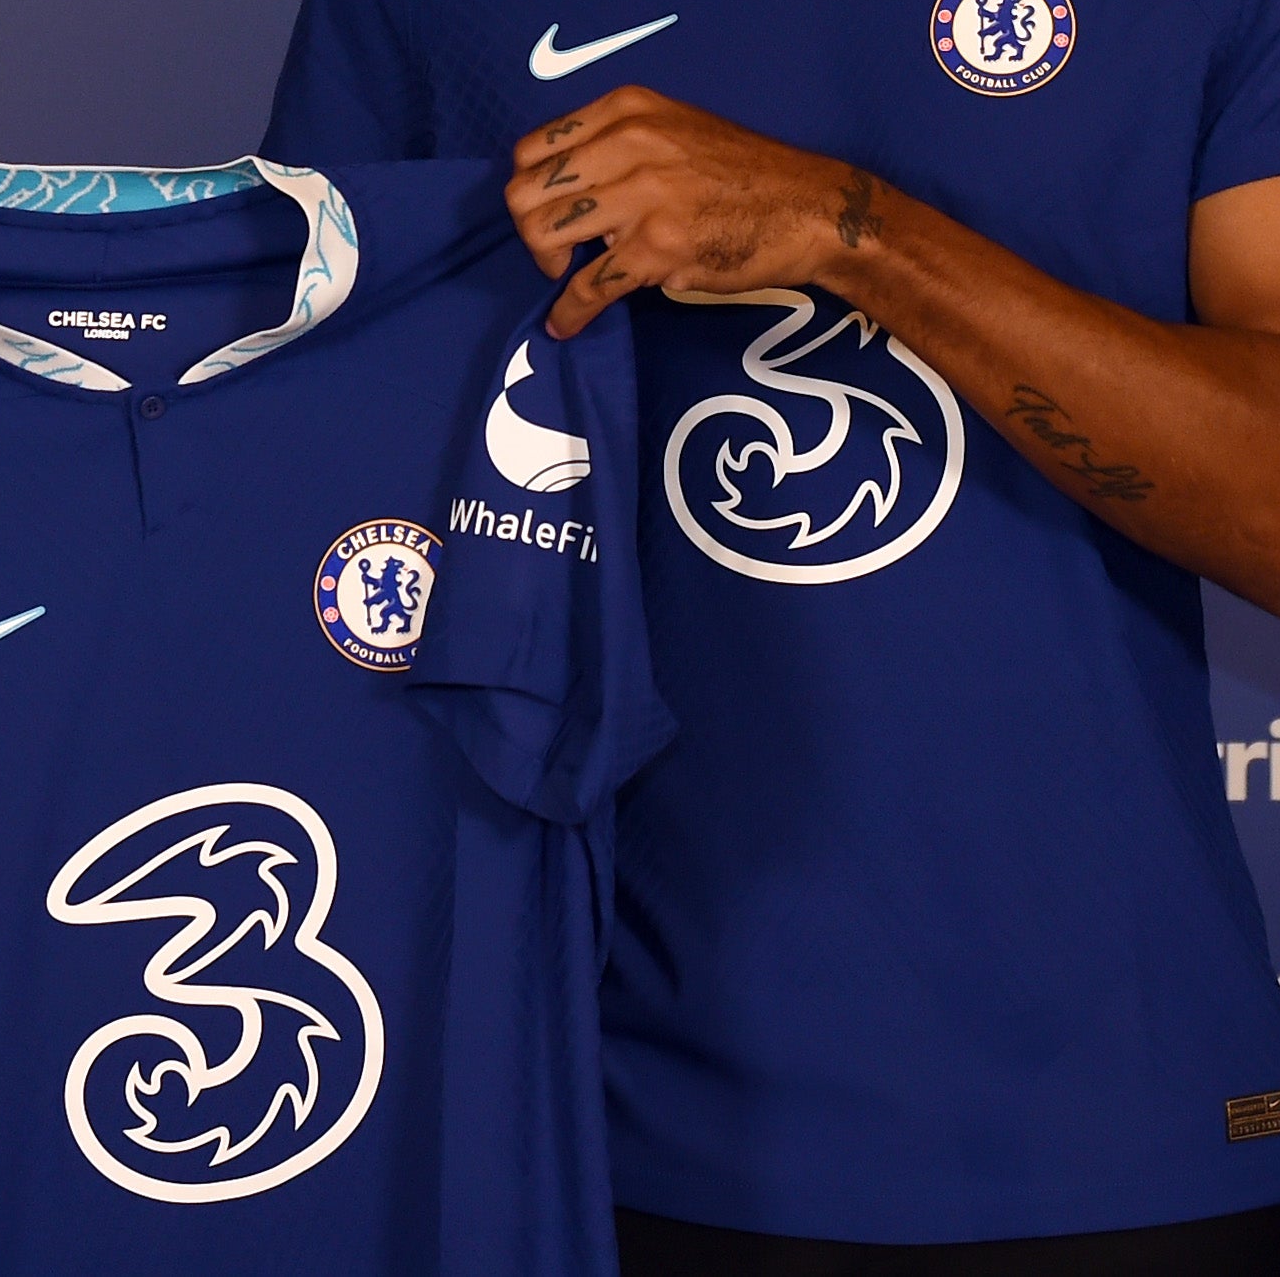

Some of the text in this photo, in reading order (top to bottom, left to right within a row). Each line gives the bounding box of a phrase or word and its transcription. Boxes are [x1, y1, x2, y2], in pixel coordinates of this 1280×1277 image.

[955, 61, 1053, 89] FOOTBALL CLUB
[48, 310, 167, 330] CHELSEA FC
[83, 328, 130, 340] LONDON
[336, 524, 433, 561] CHELSEA
[342, 637, 407, 665] FOOTBALL
[46, 783, 384, 1203] 3
